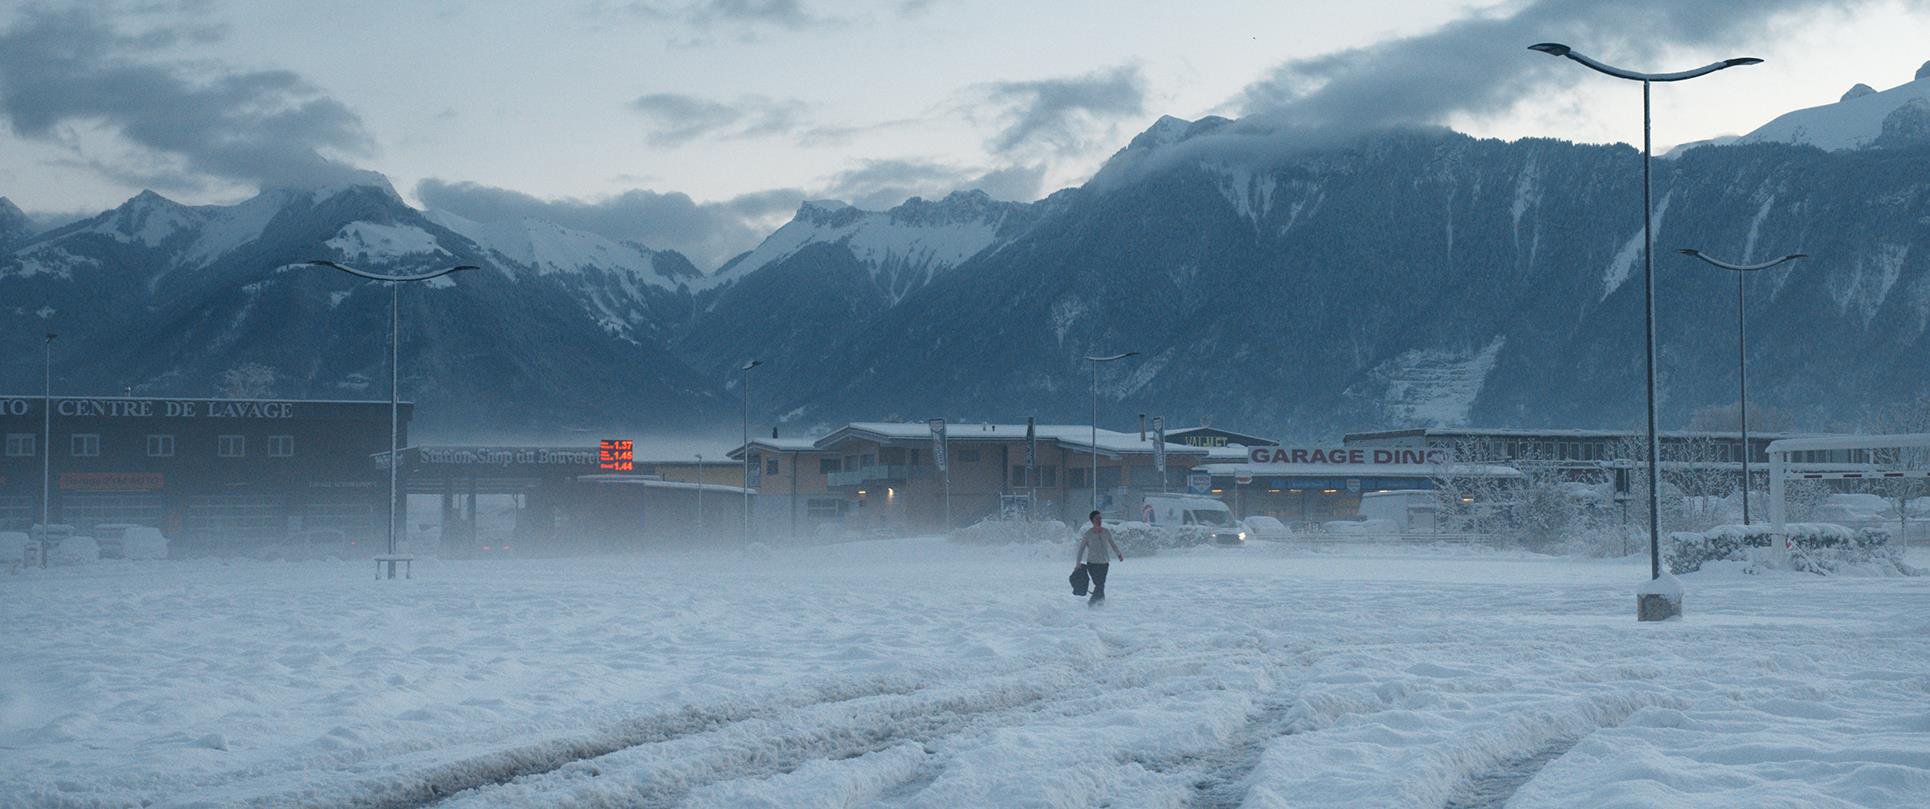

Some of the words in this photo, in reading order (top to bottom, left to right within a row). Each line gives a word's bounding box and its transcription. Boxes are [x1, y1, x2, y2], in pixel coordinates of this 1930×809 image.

[57, 399, 153, 416] CENTRE
[164, 400, 196, 417] DE
[207, 401, 293, 418] LAVAGE
[614, 441, 632, 450] 1.37
[516, 449, 534, 463] du
[1251, 448, 1364, 464] GARAGE
[614, 462, 632, 471] 1.44
